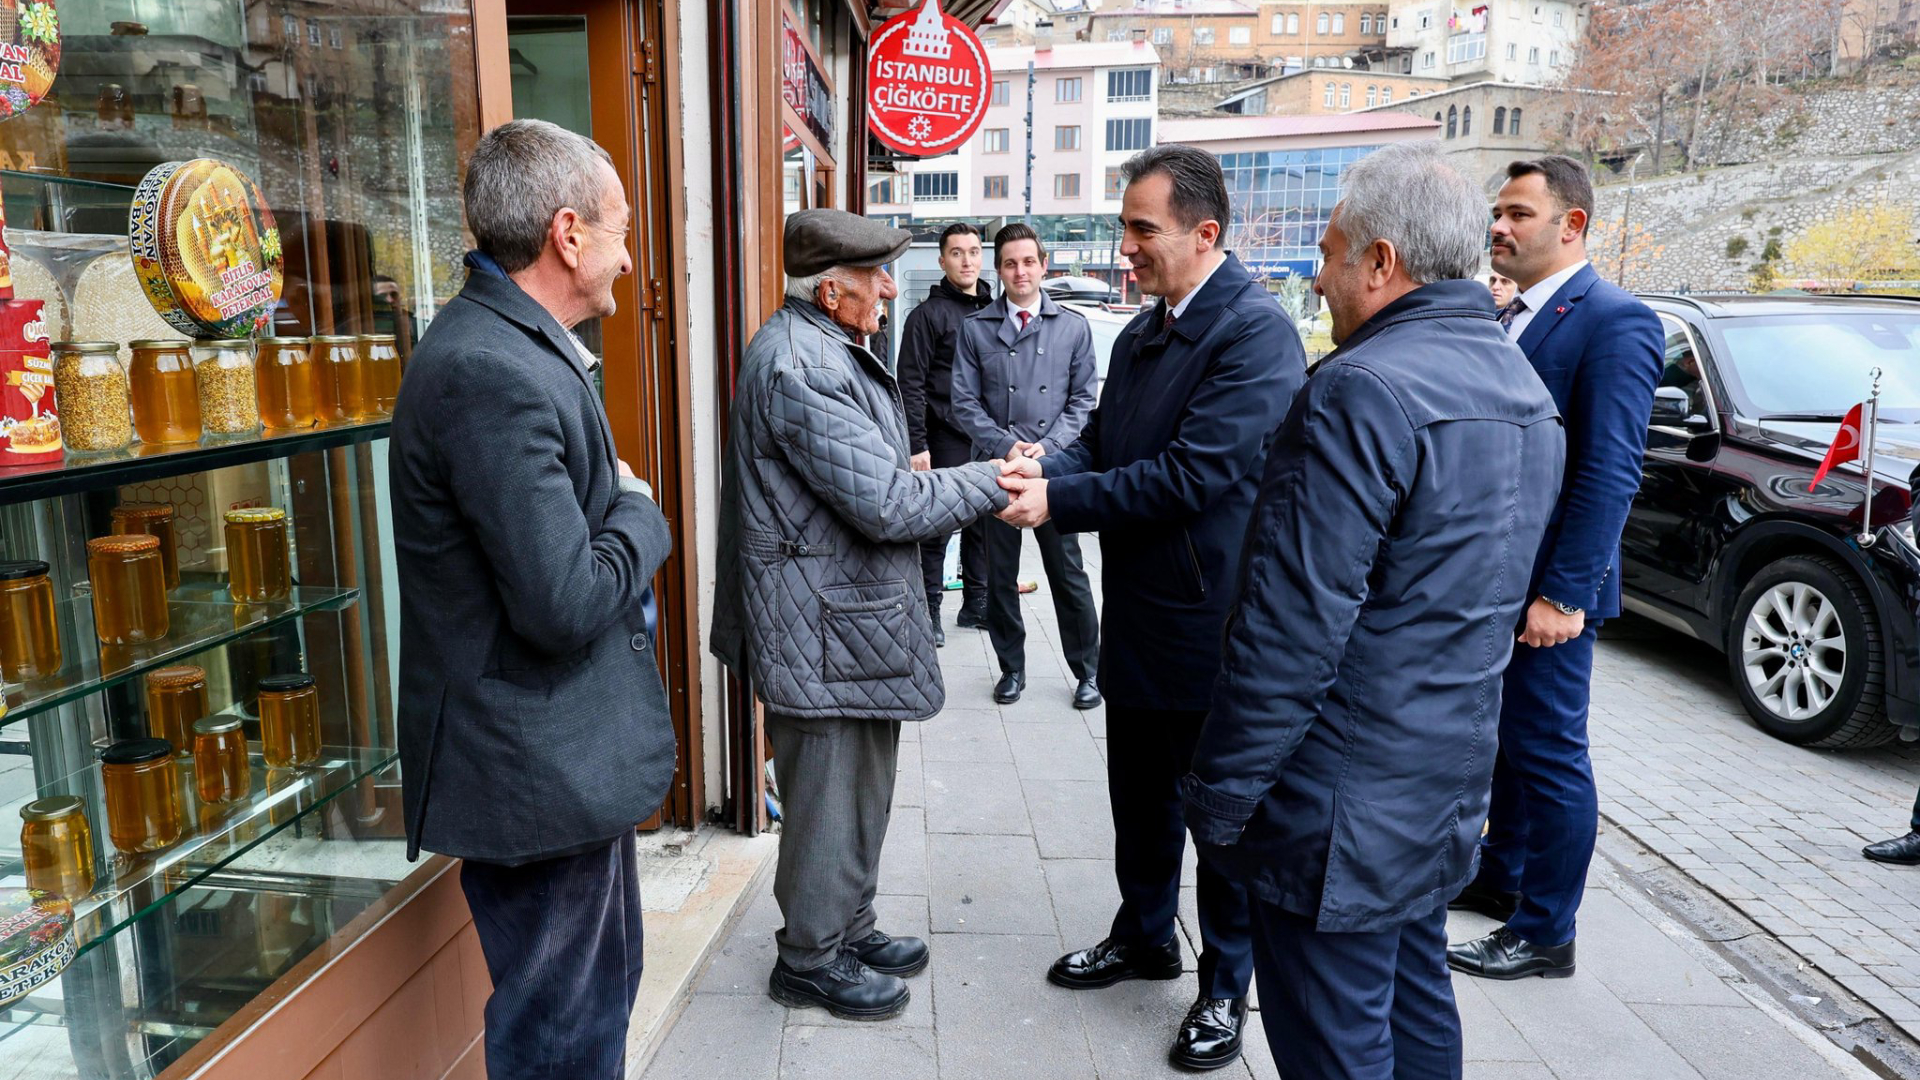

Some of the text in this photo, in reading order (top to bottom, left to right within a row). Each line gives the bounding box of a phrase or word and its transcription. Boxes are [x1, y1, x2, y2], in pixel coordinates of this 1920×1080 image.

[876, 54, 974, 87] İSTANBUL
[874, 83, 973, 113] ÇİĞKÖFTE
[131, 206, 144, 256] BALI
[211, 269, 273, 308] KARAKOVAN
[221, 261, 255, 286] BİTLİS
[221, 285, 274, 321] PETEK BAL
